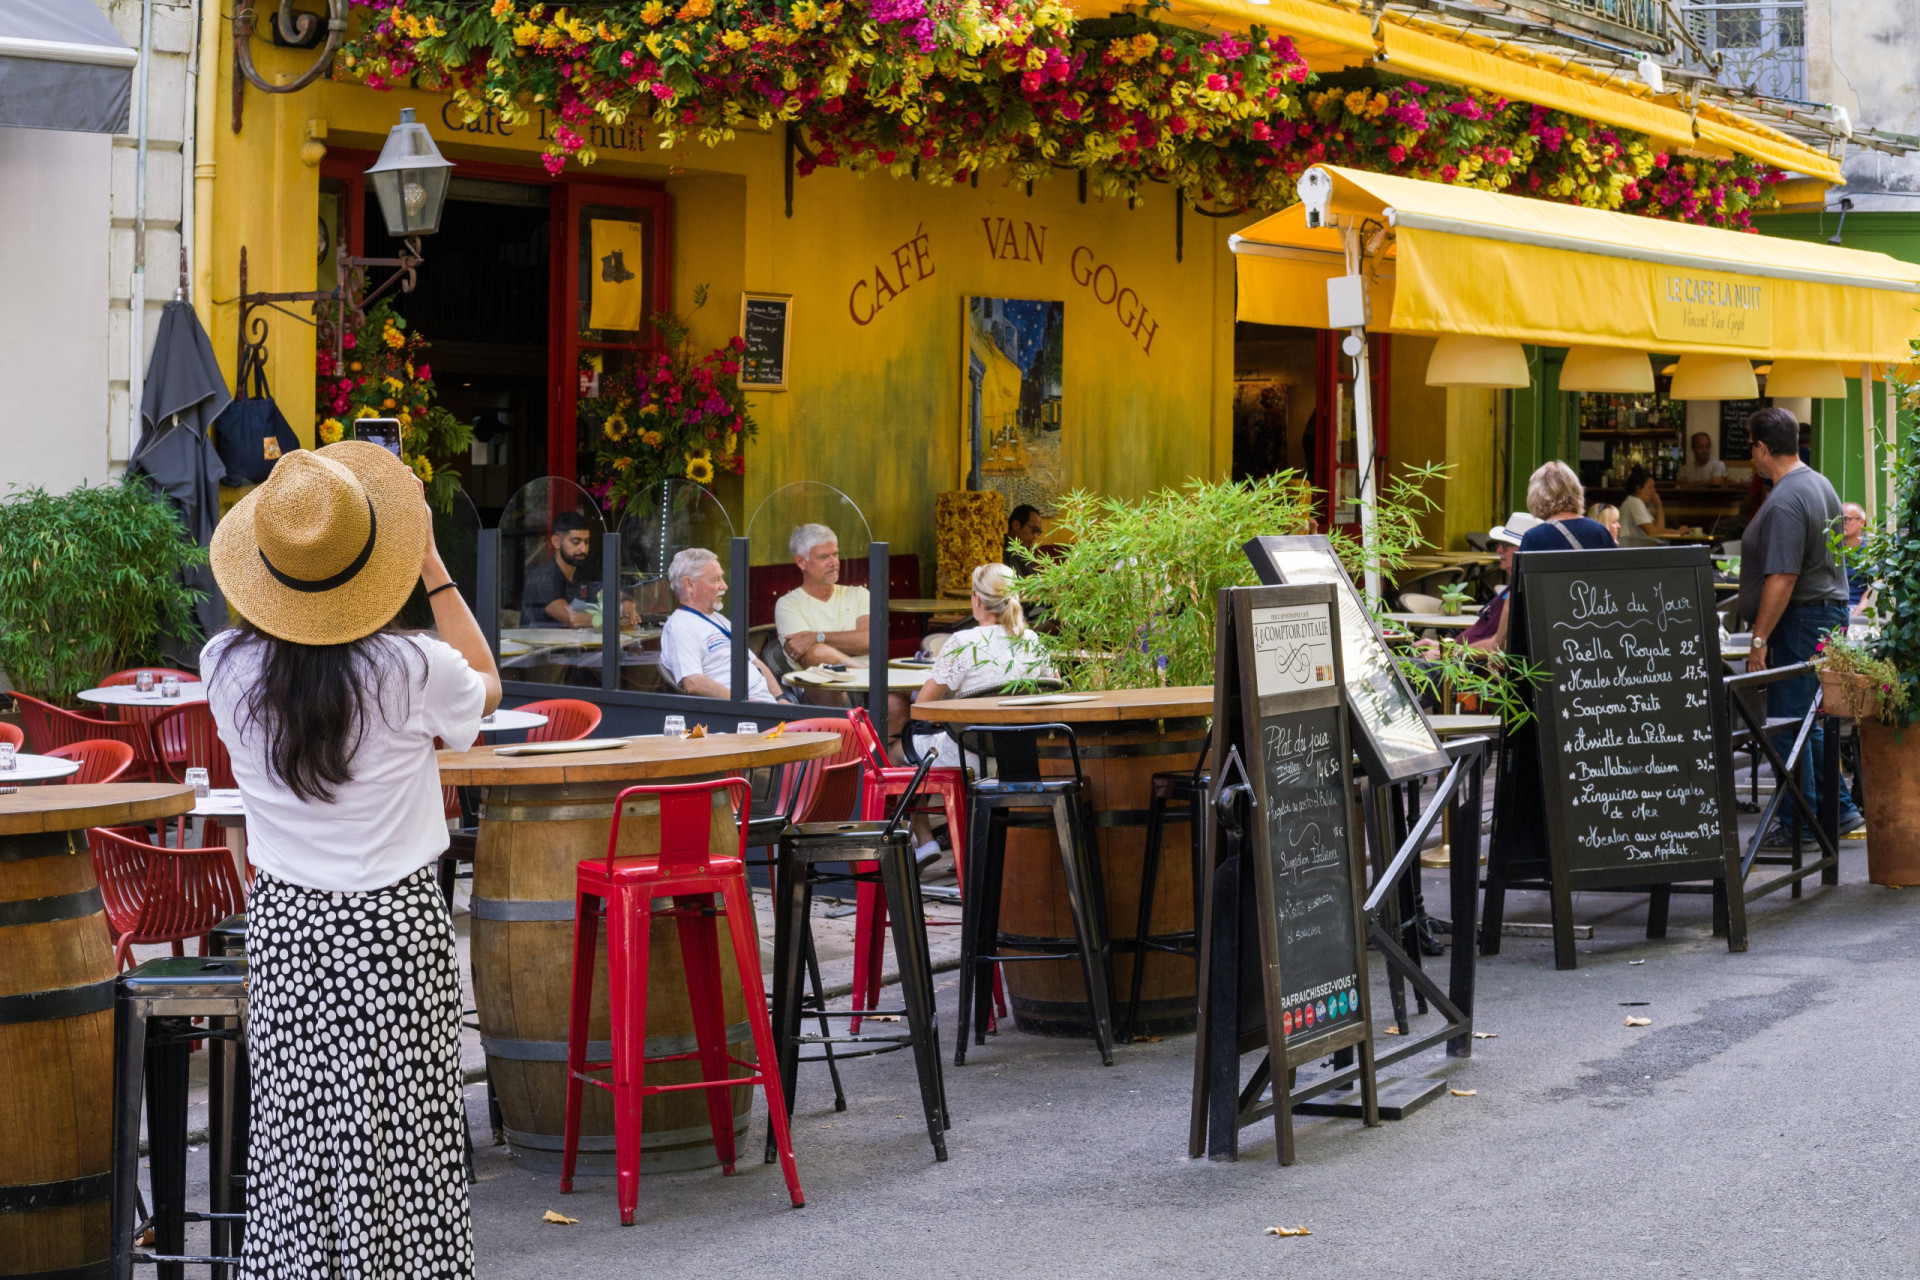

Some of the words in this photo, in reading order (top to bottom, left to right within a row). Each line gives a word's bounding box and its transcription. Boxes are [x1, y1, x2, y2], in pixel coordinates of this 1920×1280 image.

[589, 120, 646, 152] nuit
[849, 221, 936, 326] CAFÉ
[981, 217, 1048, 265] VAN
[1070, 246, 1159, 357] GOGH
[1666, 275, 1681, 302] LE
[1685, 278, 1715, 306] CAFE
[1717, 282, 1732, 308] LA
[1734, 284, 1761, 311] NUIT
[1683, 305, 1708, 328] Vincent
[1710, 309, 1726, 329] Van
[1727, 309, 1746, 340] Gogh
[1569, 580, 1619, 619] Plats
[1627, 592, 1648, 613] du
[1653, 581, 1693, 632] Jour
[1264, 623, 1301, 642] COMPTOIR
[1301, 620, 1329, 638] D'ITALIE
[1563, 637, 1613, 662] Paëlla
[1619, 633, 1672, 673] Royale
[1567, 668, 1611, 692] Moules
[1264, 725, 1293, 761] Plat
[1293, 724, 1307, 752] du
[1574, 726, 1624, 751] Assiette
[1627, 727, 1642, 745] du
[1645, 754, 1679, 775] Maison
[1641, 788, 1662, 800] aux
[1666, 781, 1705, 806] cigales
[1610, 806, 1624, 820] de
[1635, 830, 1657, 843] aux
[1660, 829, 1700, 845] agrumes
[1624, 844, 1653, 861] Bon
[1281, 976, 1352, 1009] RAFRAICHISSEZ-VOUS
